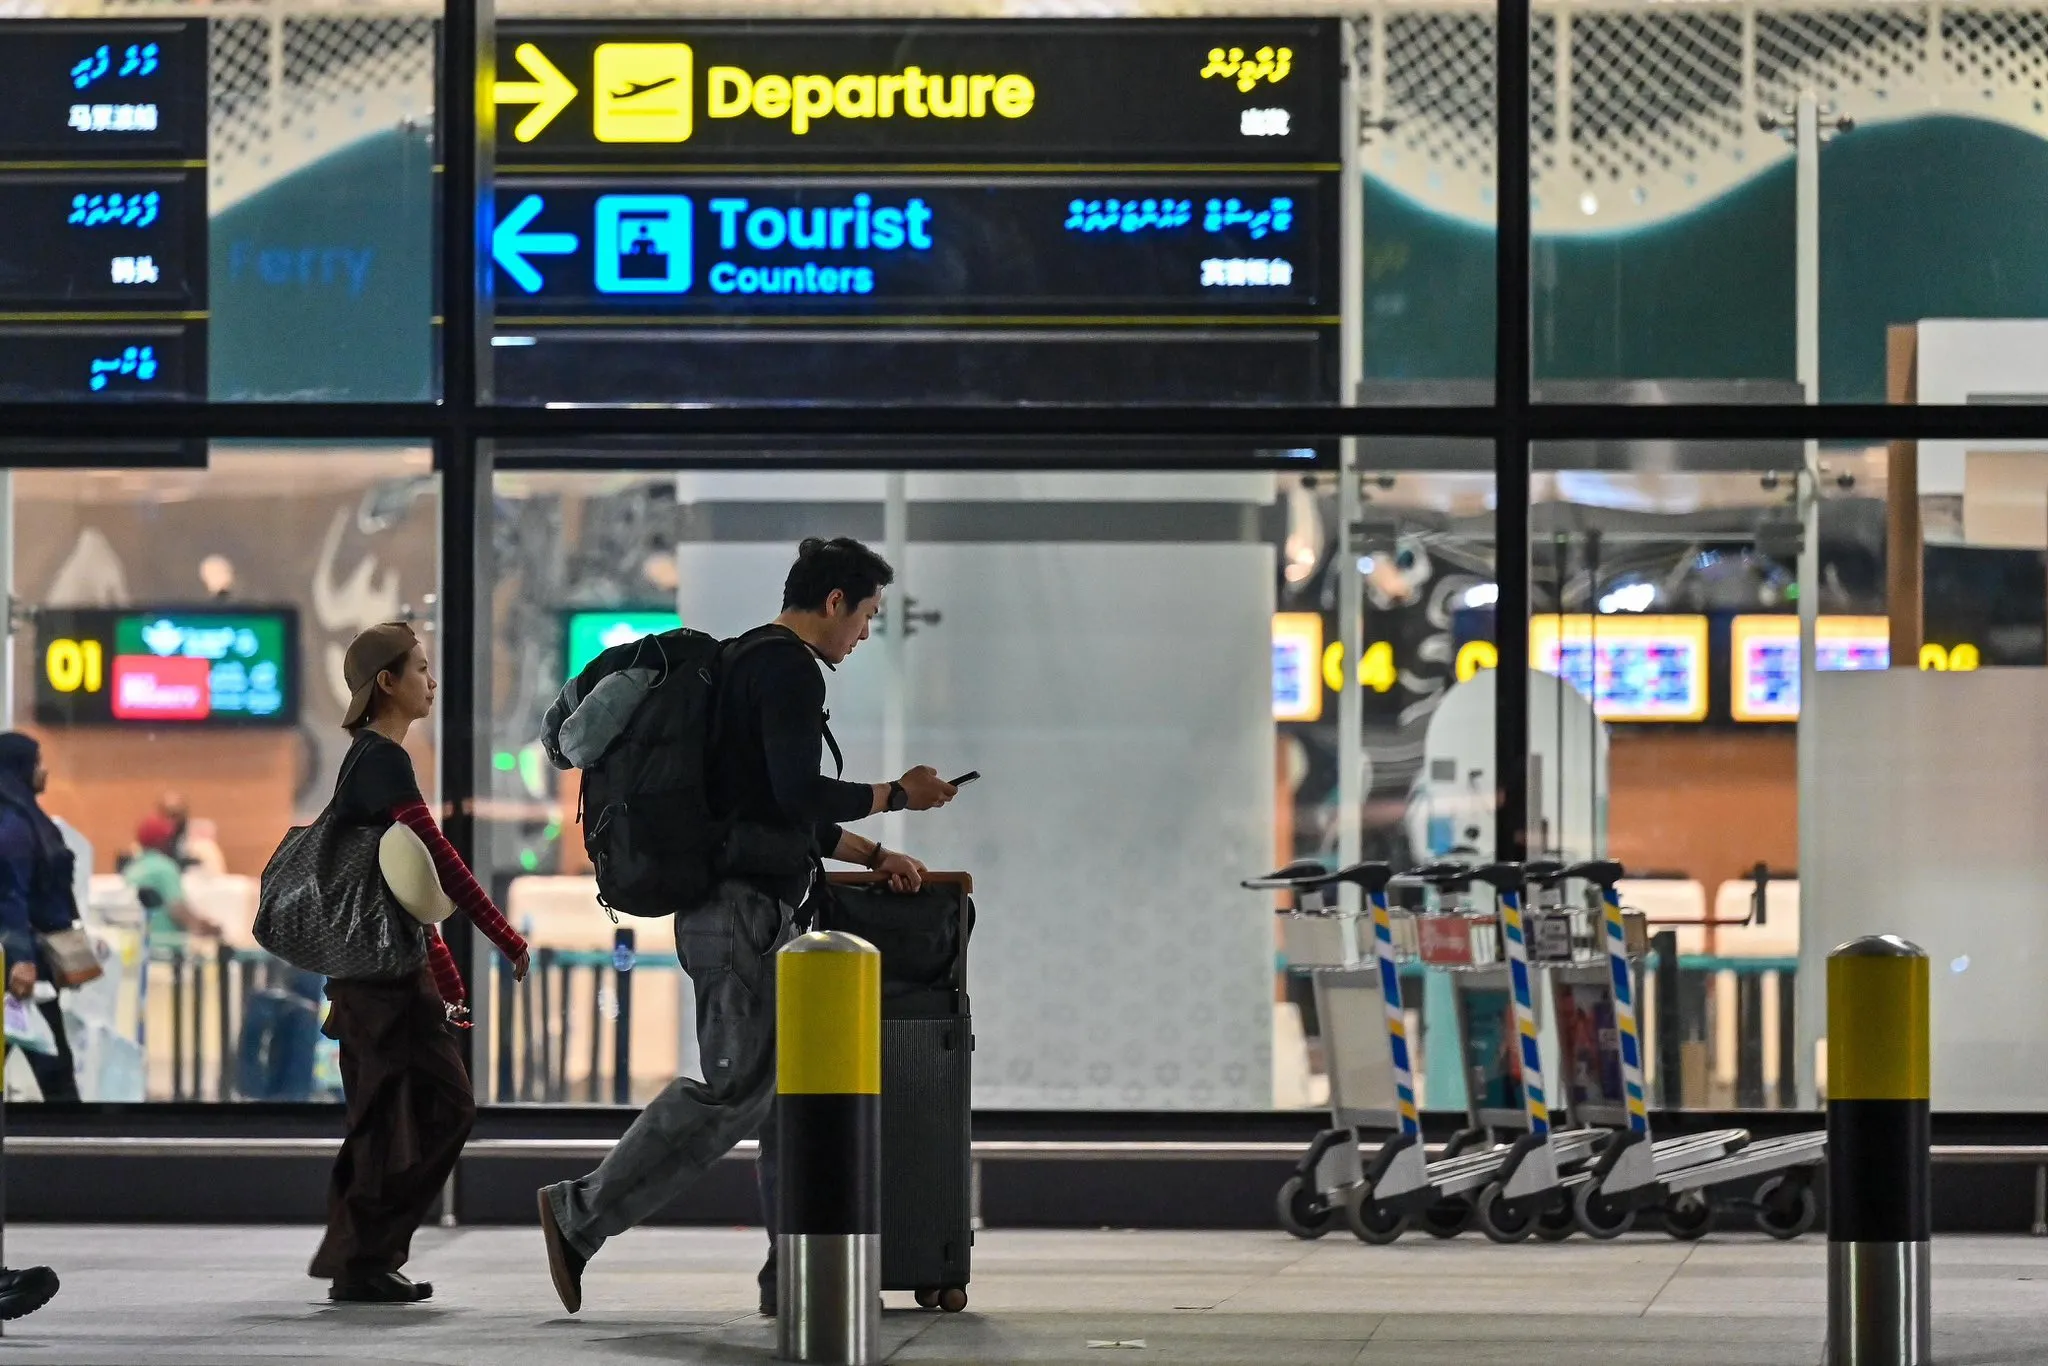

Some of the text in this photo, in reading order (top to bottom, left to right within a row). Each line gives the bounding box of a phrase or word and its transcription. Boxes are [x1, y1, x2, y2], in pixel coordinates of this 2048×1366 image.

[707, 65, 1036, 135] Departure
[709, 193, 934, 252] Tourist
[709, 261, 875, 295] Counters
[46, 638, 102, 693] 01
